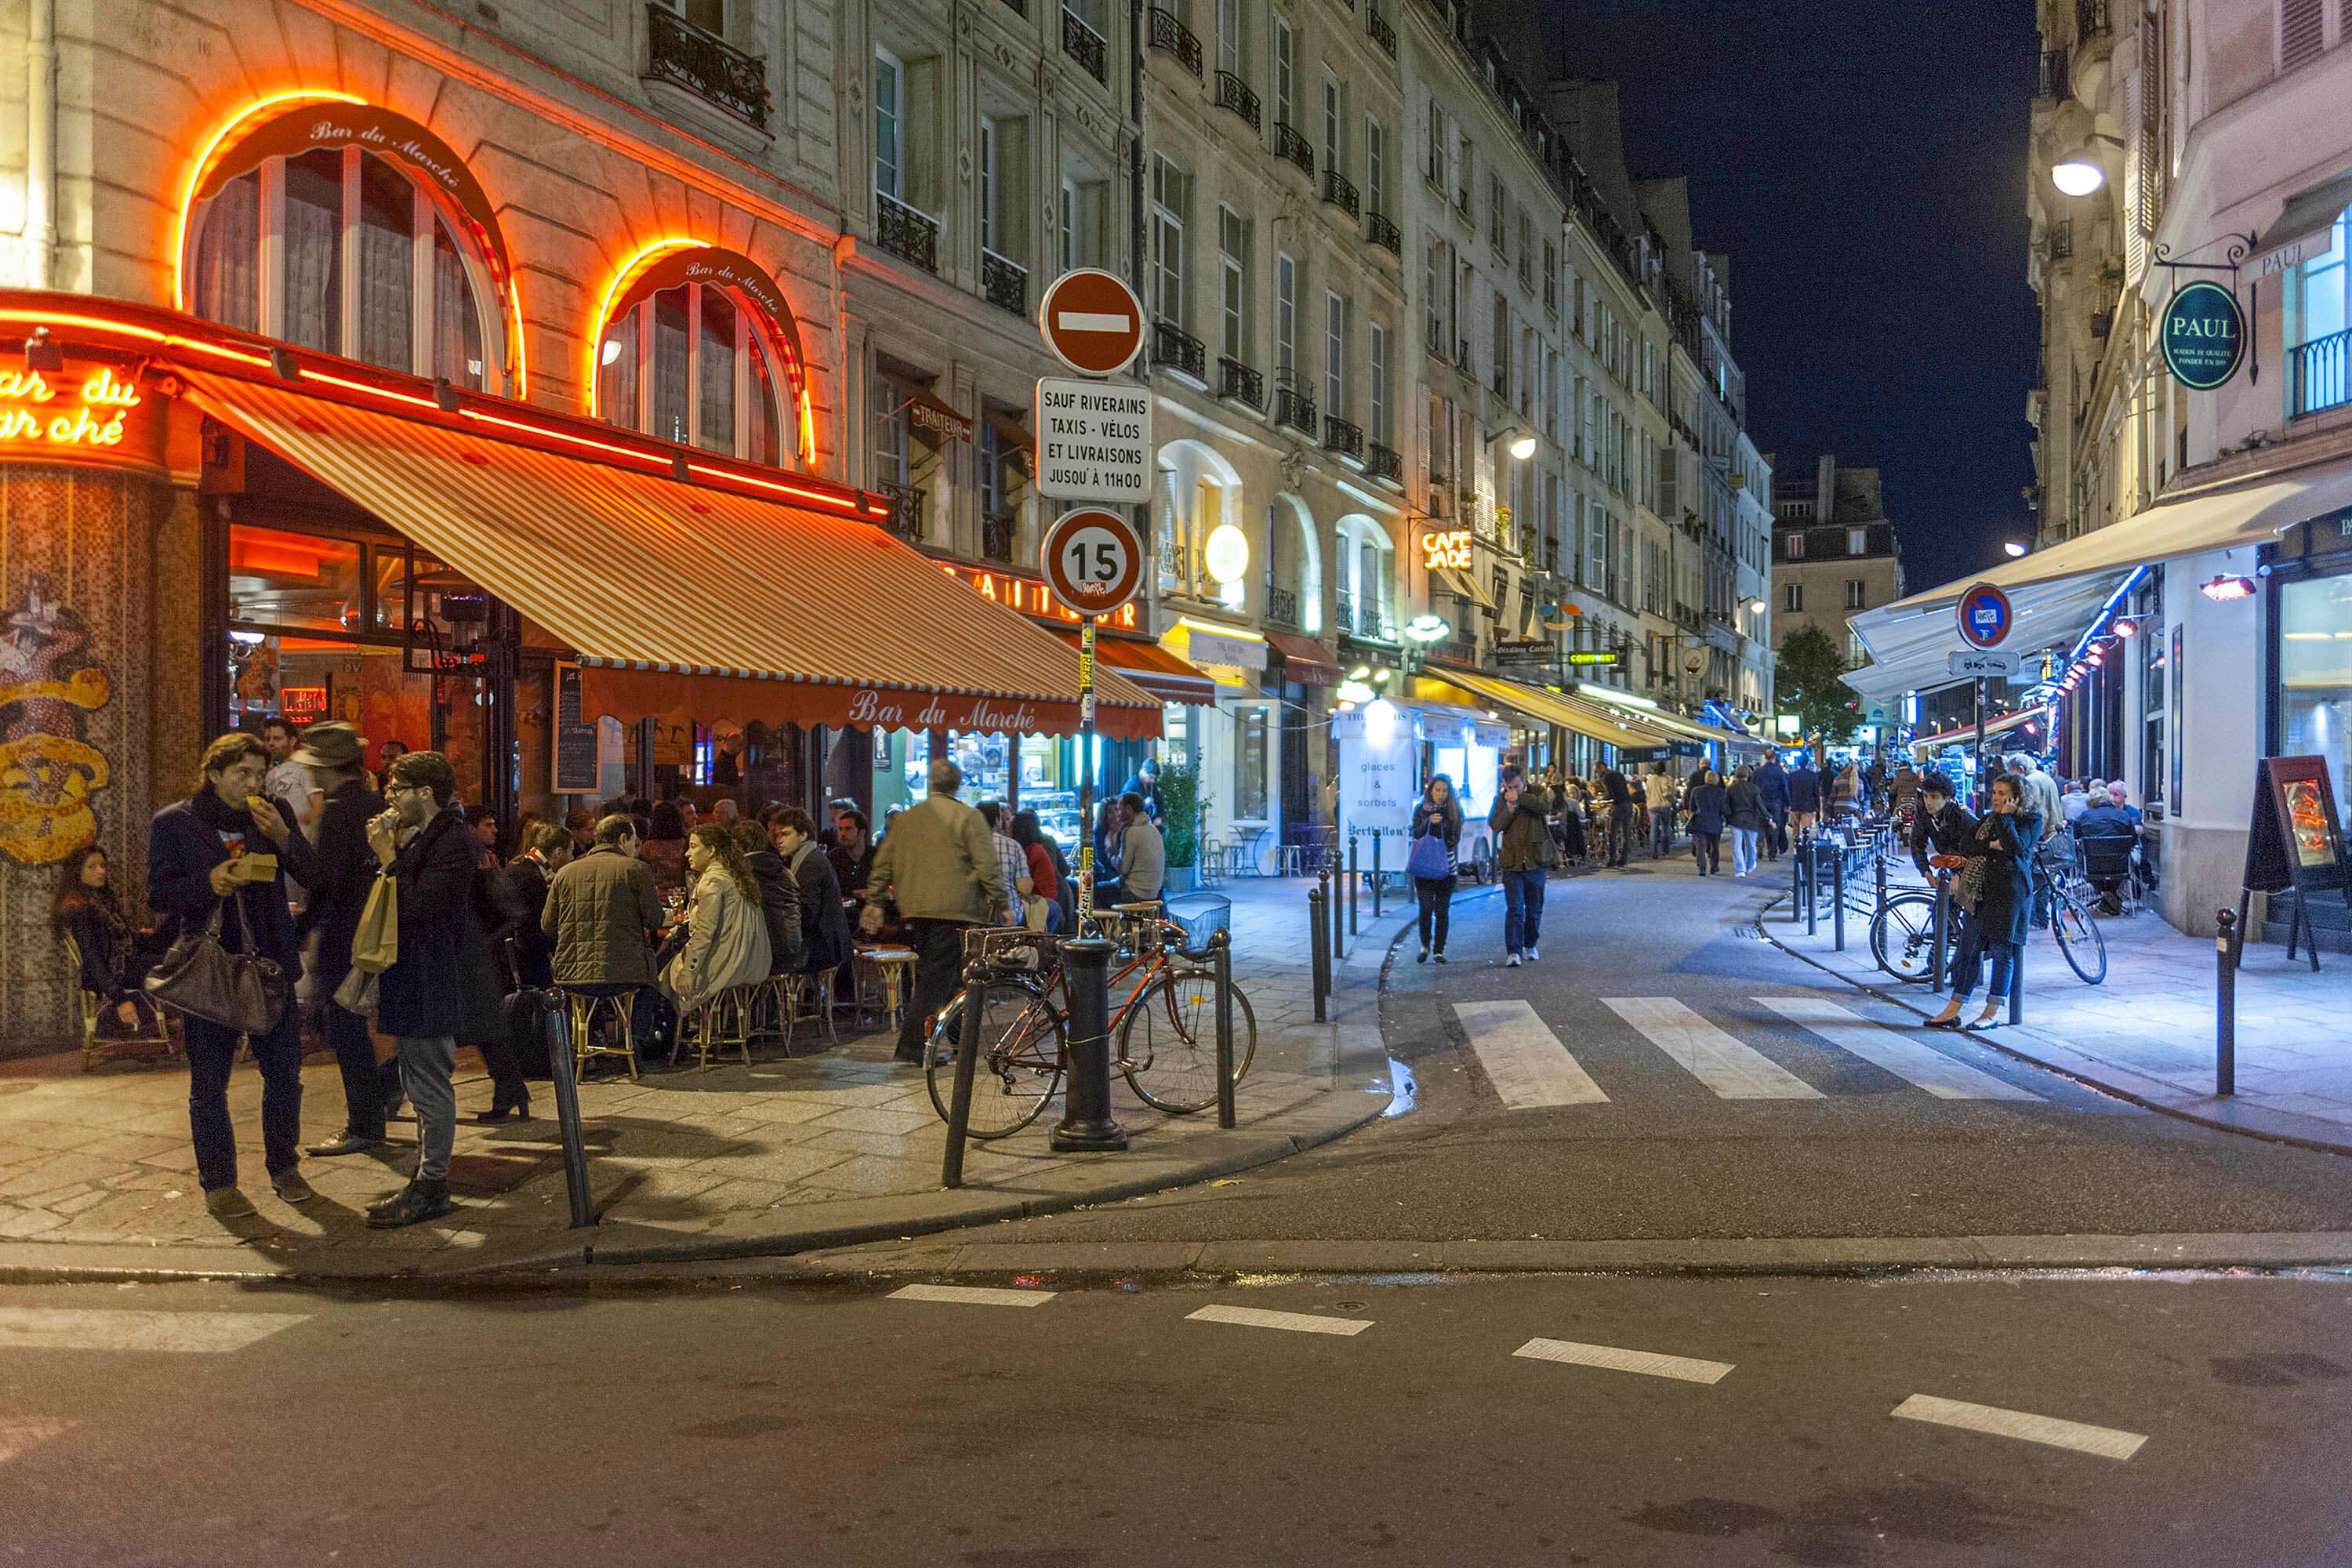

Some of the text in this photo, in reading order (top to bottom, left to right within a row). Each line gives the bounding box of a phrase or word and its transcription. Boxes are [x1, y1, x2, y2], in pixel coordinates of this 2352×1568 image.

[310, 121, 459, 188] Bar du Marché
[2262, 244, 2307, 276] PAUL
[685, 262, 779, 313] Bar du Marché
[2172, 317, 2237, 339] PAUL
[0, 367, 142, 406] ar du
[1044, 392, 1146, 415] SAUF RIVERAINS
[920, 405, 963, 437] TRAITEUR
[1051, 418, 1087, 435] TAXIS
[1102, 419, 1140, 439] VÉLOS
[1048, 443, 1142, 464] ET LIVRAISONS
[1104, 472, 1142, 488] 11H00
[1071, 543, 1119, 581] 15
[1424, 549, 1472, 568] JADE
[848, 689, 1036, 729] Bar du Marché
[1360, 762, 1396, 771] glaces
[1374, 780, 1381, 789] &
[1357, 798, 1397, 808] sorbets
[1347, 816, 1403, 837] Berthllon
